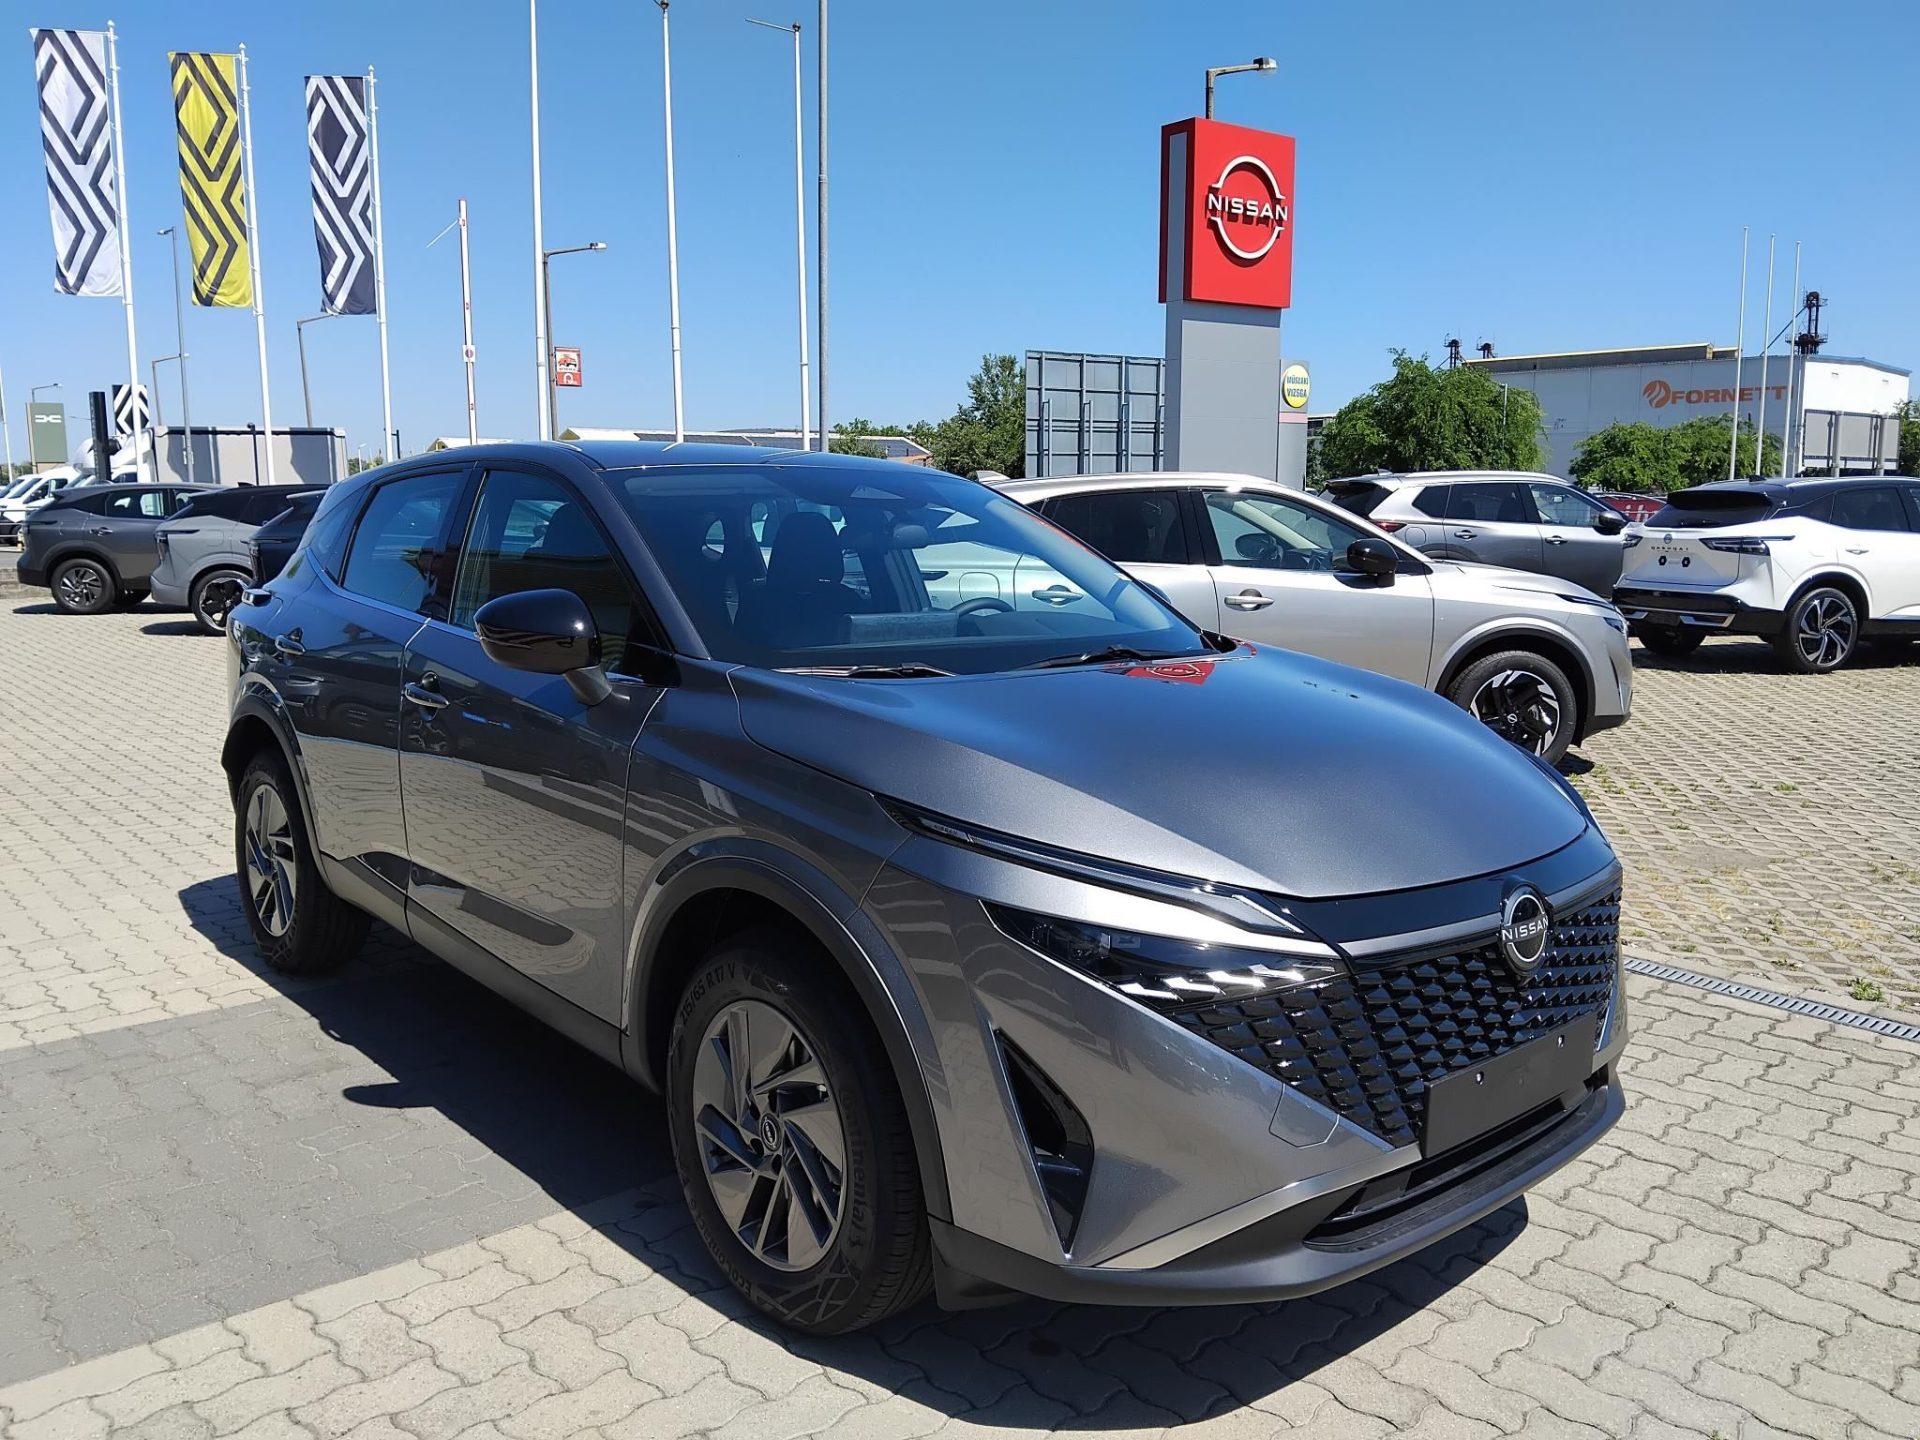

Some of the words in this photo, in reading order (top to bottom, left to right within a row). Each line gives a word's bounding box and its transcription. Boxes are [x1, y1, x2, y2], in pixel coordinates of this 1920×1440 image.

[1208, 193, 1288, 220] NISSAN
[1501, 916, 1549, 941] NISSAN
[679, 978, 706, 1026] 215/65
[727, 960, 736, 979] V
